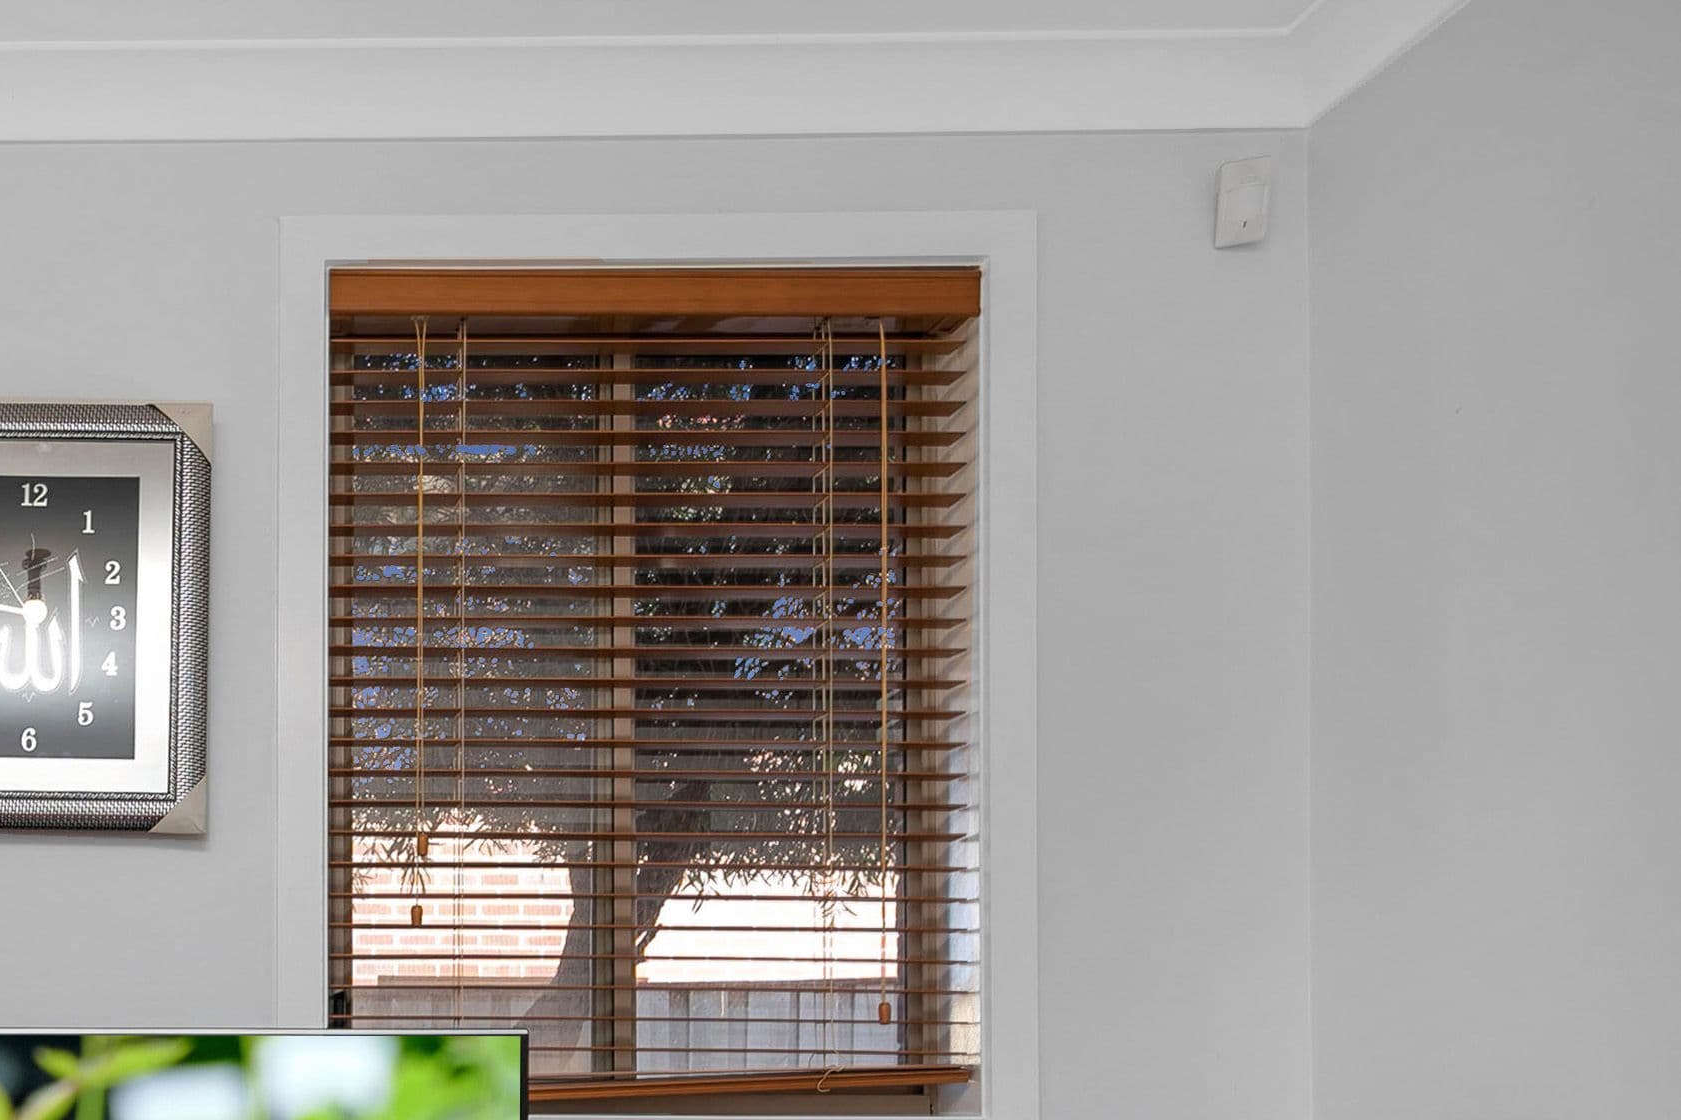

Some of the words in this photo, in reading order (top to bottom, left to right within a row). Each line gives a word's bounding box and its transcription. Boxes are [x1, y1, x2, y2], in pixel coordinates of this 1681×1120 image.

[21, 483, 48, 507] 12
[82, 510, 96, 534] 1
[104, 560, 121, 585] 2
[110, 605, 127, 631] 3
[101, 651, 118, 676] 4
[78, 701, 94, 726] 5
[21, 727, 37, 752] 6
